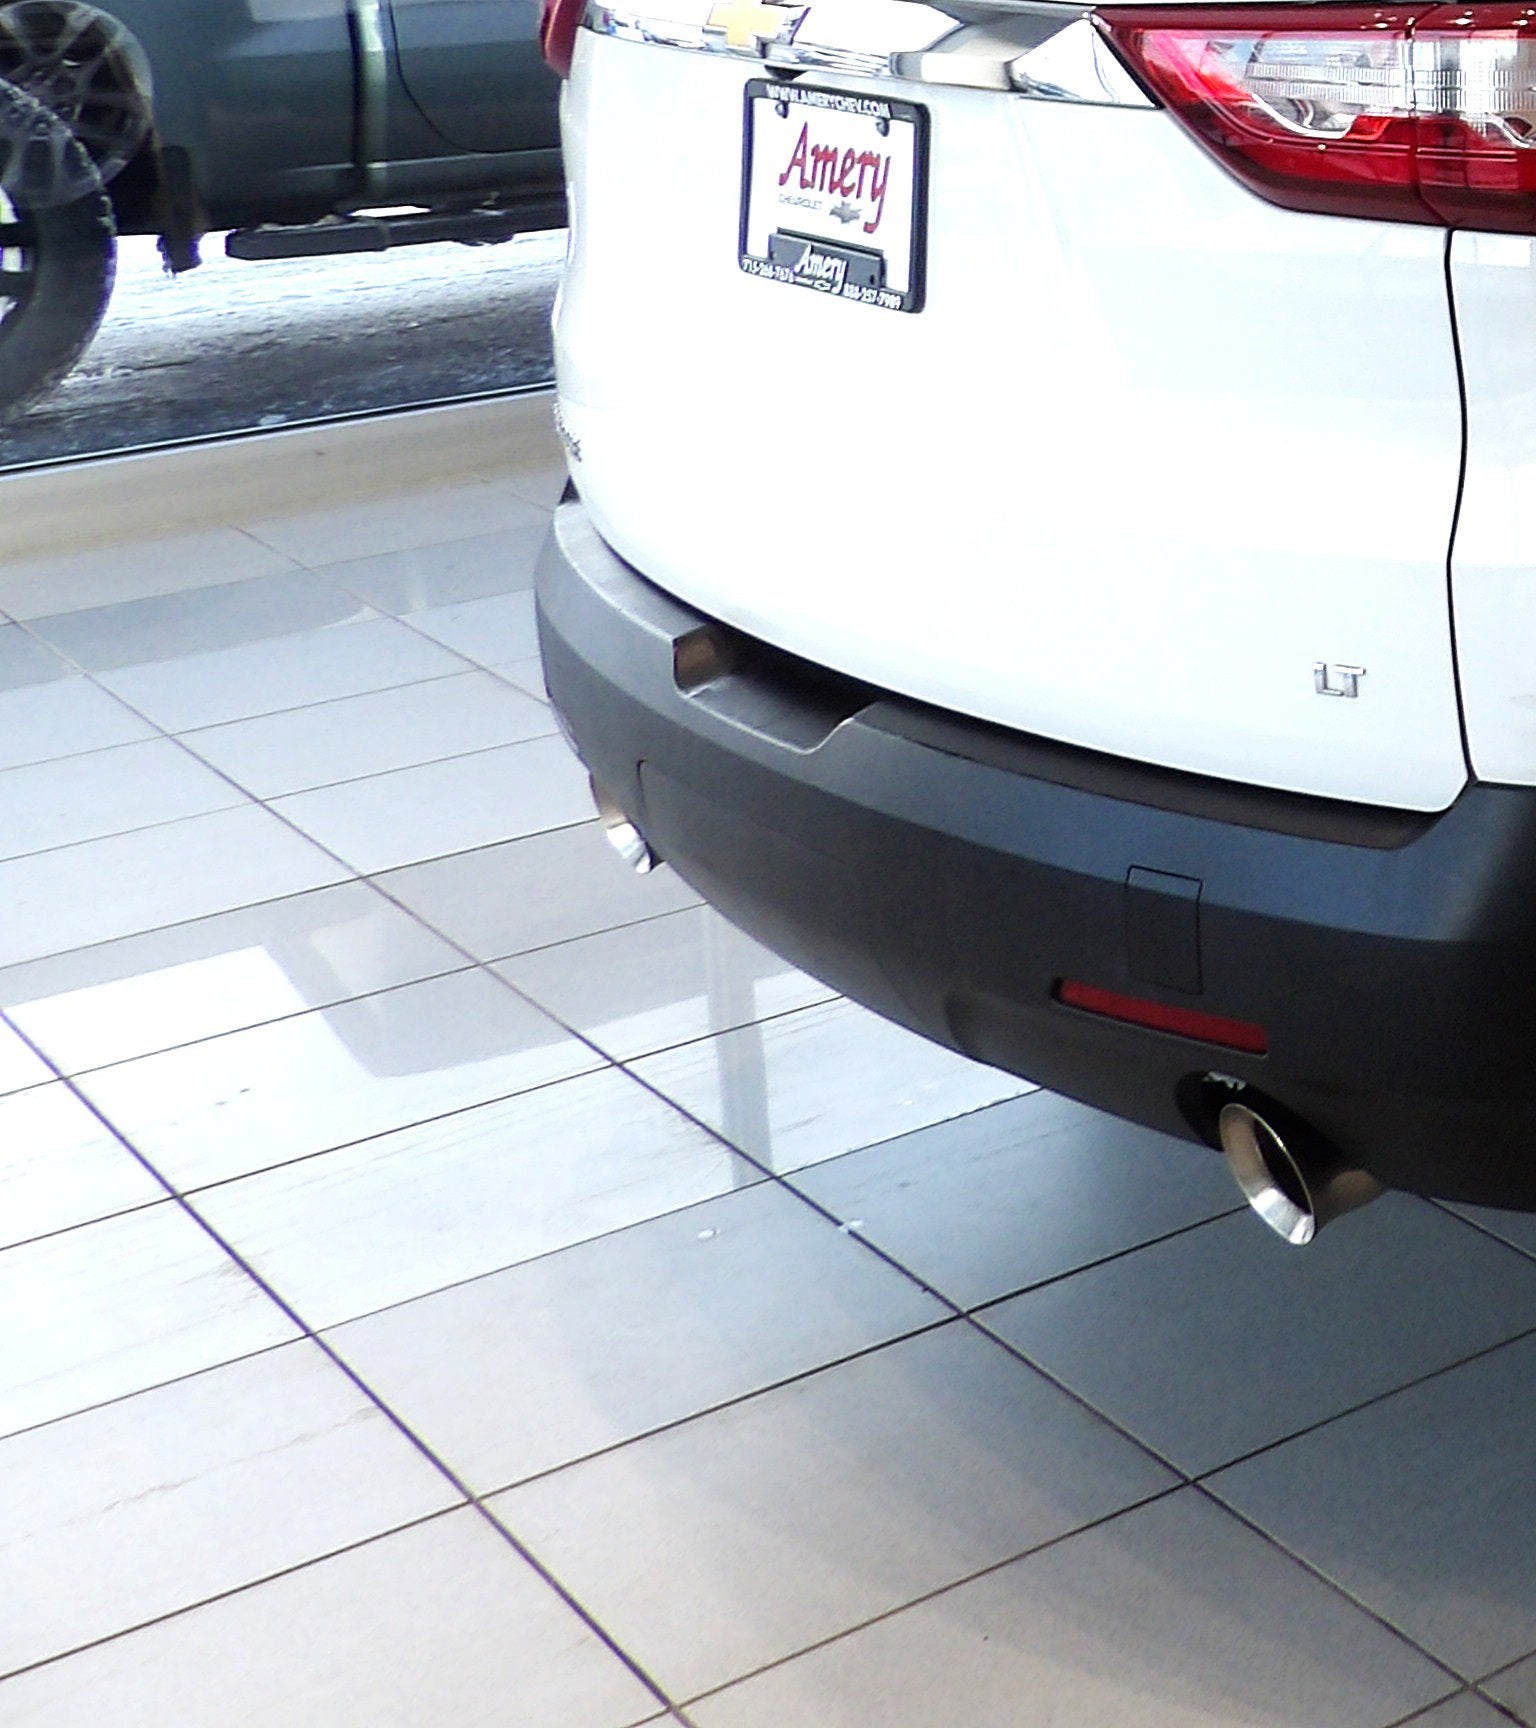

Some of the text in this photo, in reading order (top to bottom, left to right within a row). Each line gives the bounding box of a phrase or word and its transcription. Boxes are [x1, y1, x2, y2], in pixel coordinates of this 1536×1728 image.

[779, 122, 890, 233] Amery
[794, 244, 847, 293] Amery
[1312, 661, 1366, 699] LT
